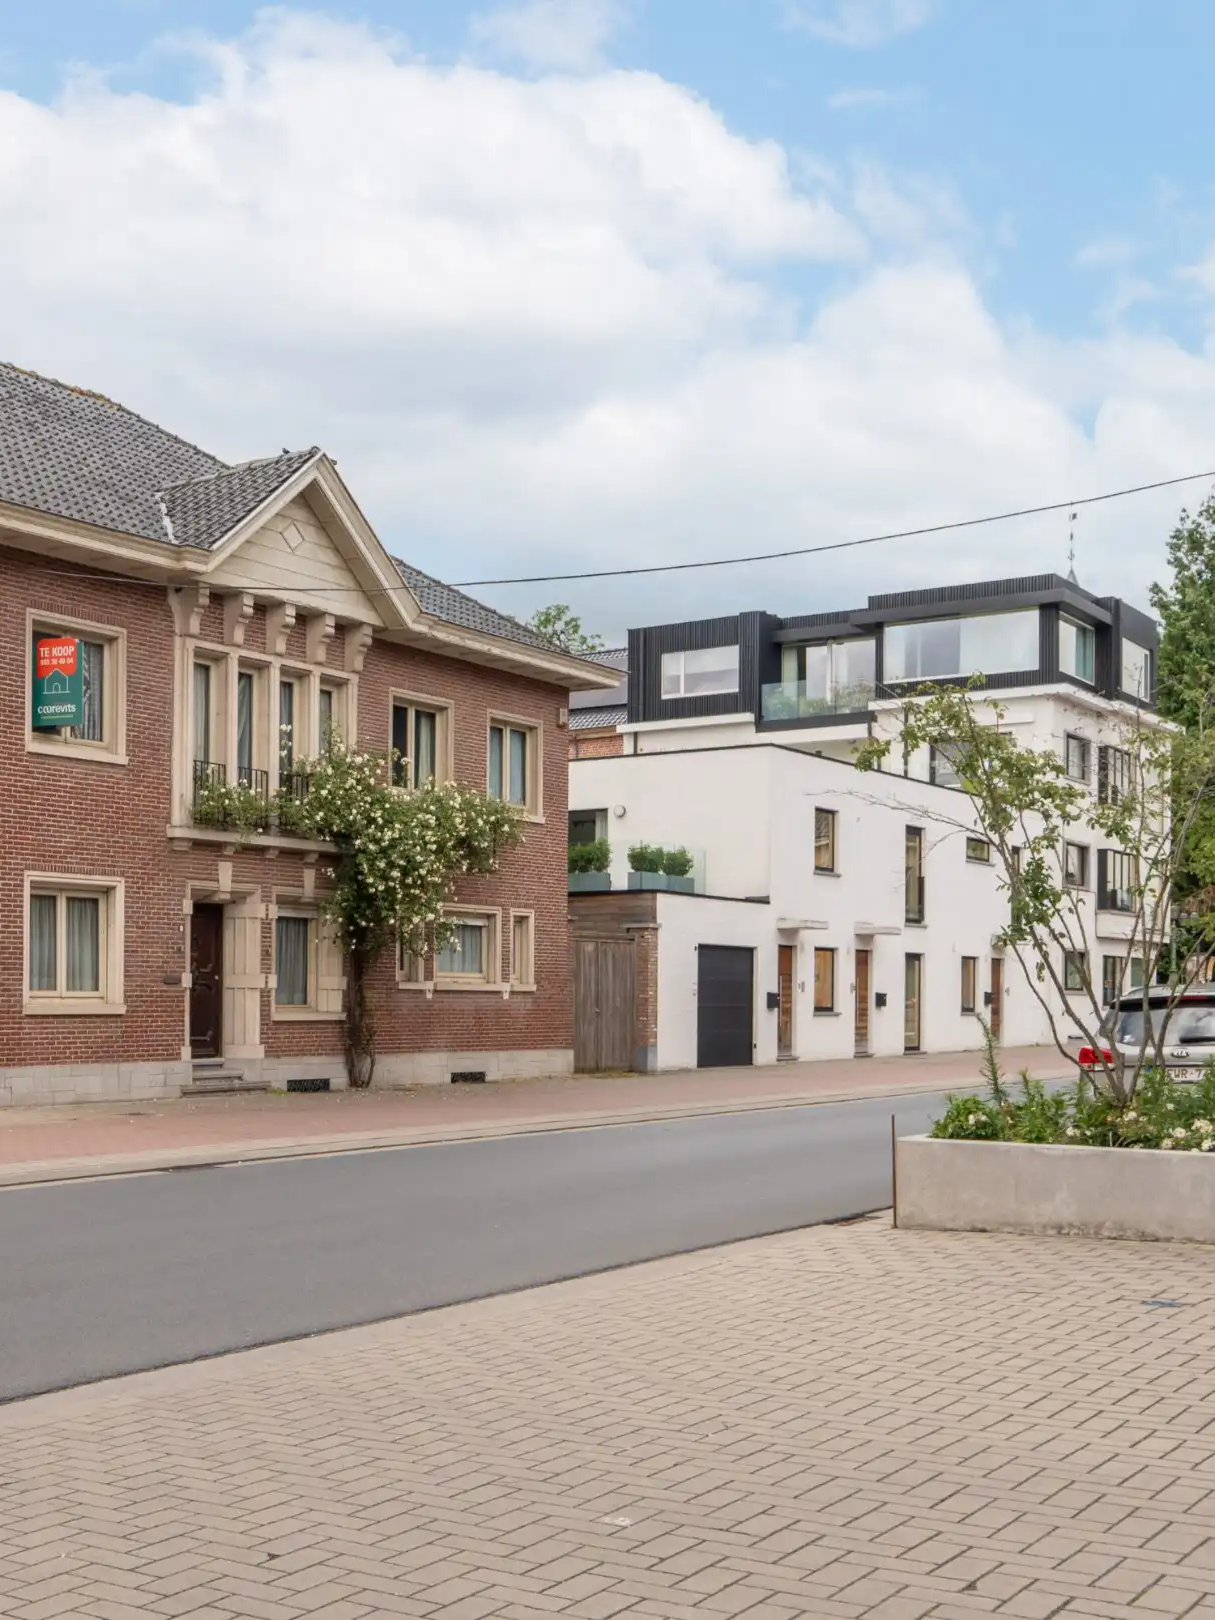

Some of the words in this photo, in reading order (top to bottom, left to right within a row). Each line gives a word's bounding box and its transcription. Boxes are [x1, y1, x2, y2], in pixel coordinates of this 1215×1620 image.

[39, 648, 50, 657] TE
[52, 646, 75, 656] KOOP
[37, 704, 77, 713] coorevits
